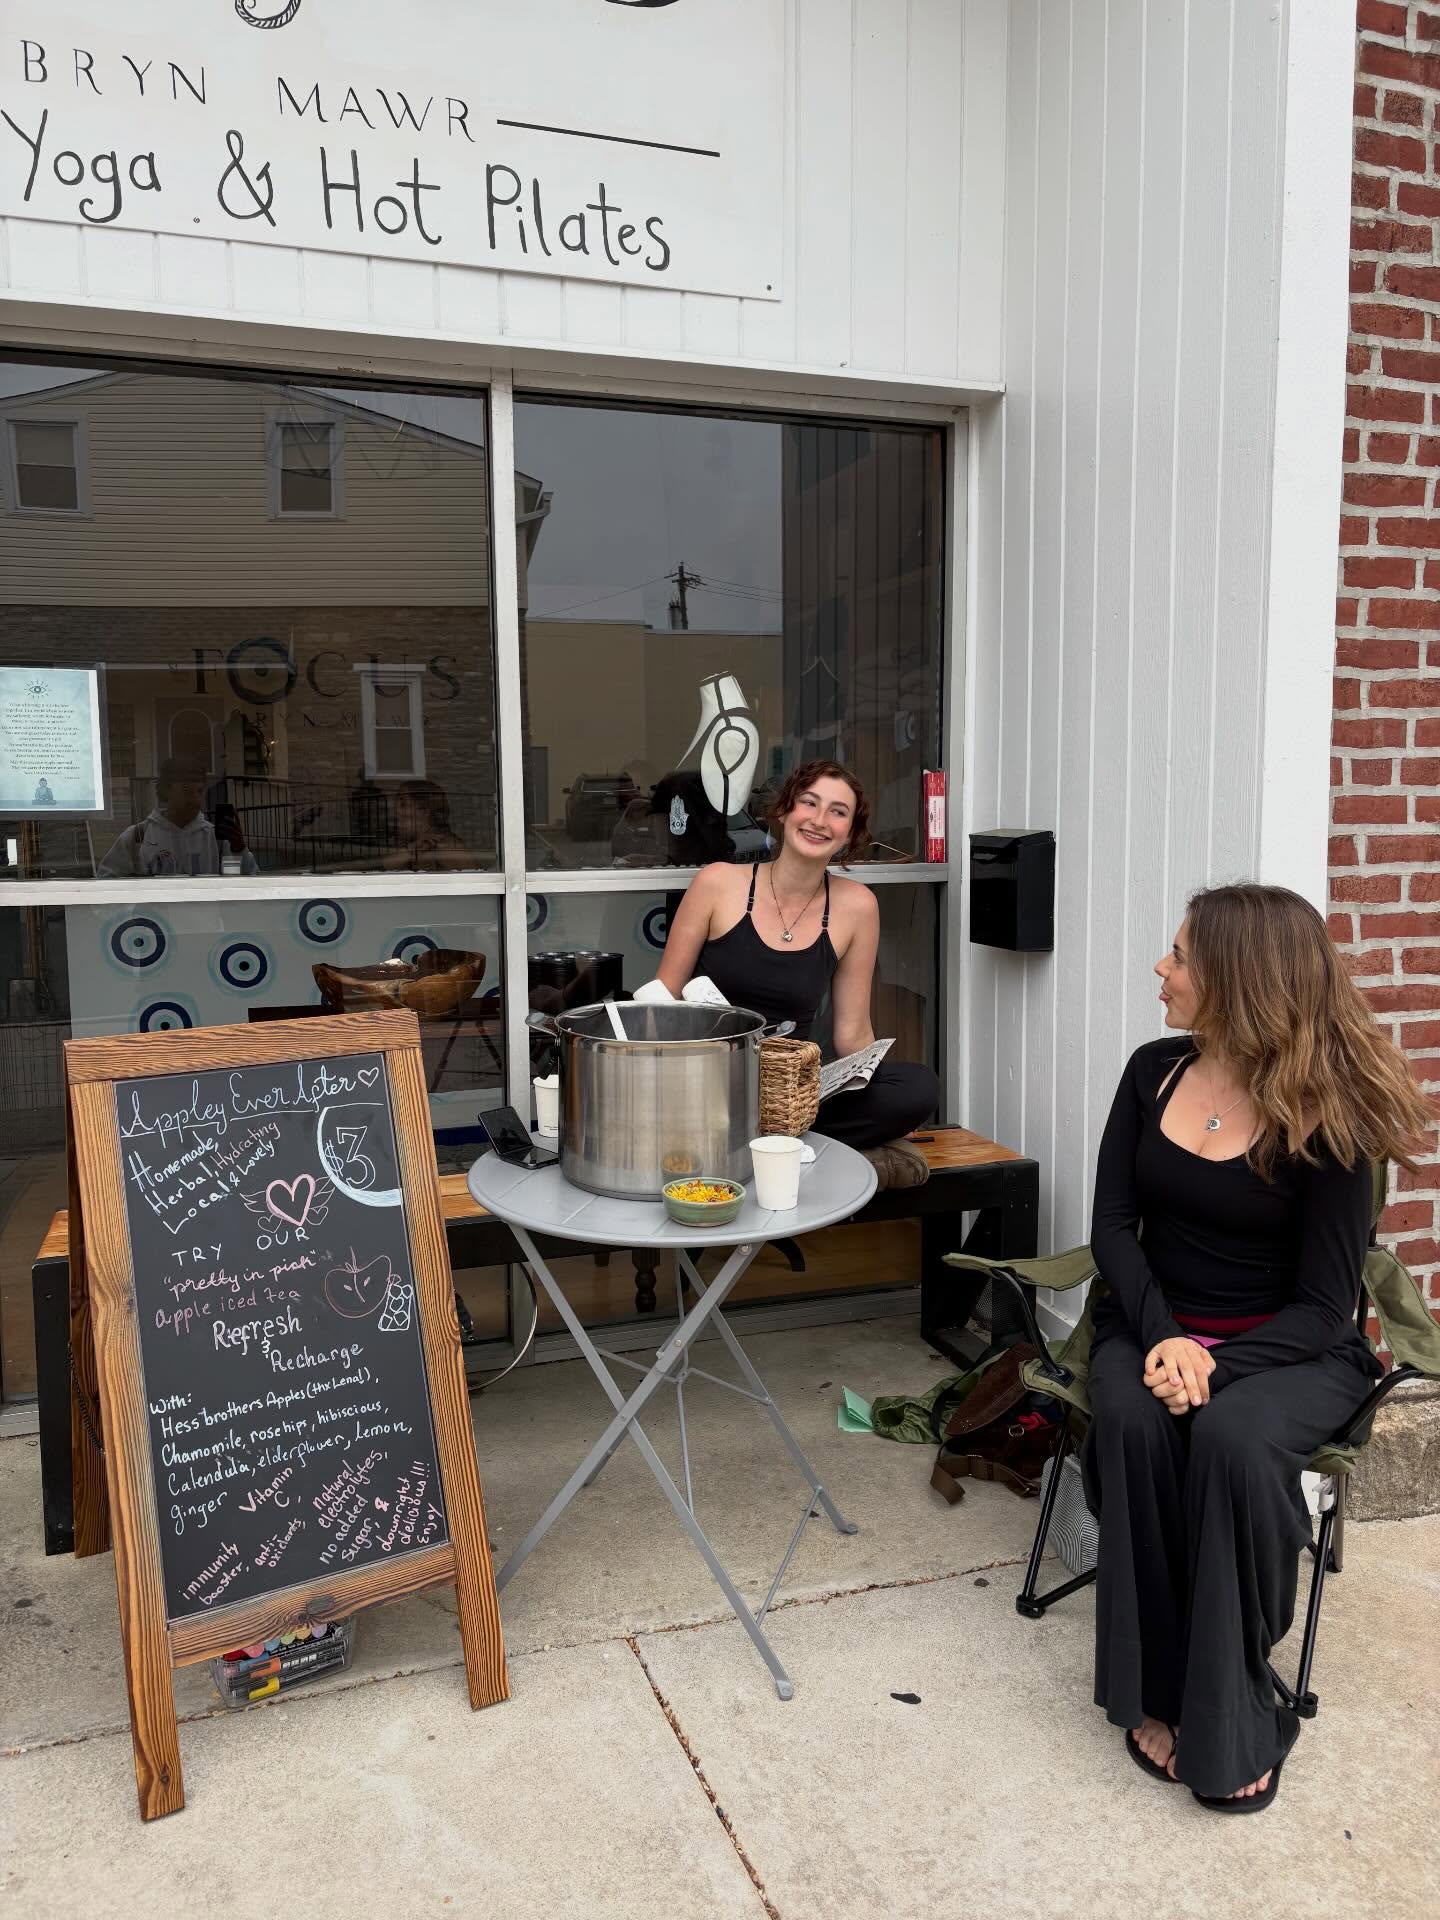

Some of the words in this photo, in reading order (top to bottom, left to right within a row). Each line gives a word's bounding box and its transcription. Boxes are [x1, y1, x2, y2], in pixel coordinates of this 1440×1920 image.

[20, 39, 207, 104] BRYN
[277, 77, 475, 143] MAWR
[0, 109, 161, 223] Yoga
[217, 129, 276, 227] &
[320, 146, 441, 245] Hot
[486, 163, 670, 271] Pilates
[229, 1073, 289, 1113] Ever
[293, 1063, 357, 1113] After
[171, 1243, 222, 1266] TRY
[256, 1227, 310, 1250] OUR
[219, 1288, 257, 1312] iced
[243, 1268, 265, 1283] in
[212, 1304, 303, 1356] Refresh
[269, 1343, 364, 1373] Recharge
[160, 1416, 200, 1439] Hess
[198, 1402, 264, 1426] brothers
[312, 1459, 355, 1511] natural
[171, 1491, 228, 1535] ginger
[319, 1543, 338, 1565] no
[335, 1494, 369, 1541] added
[376, 1476, 413, 1552] downright
[178, 1541, 240, 1600] immunity
